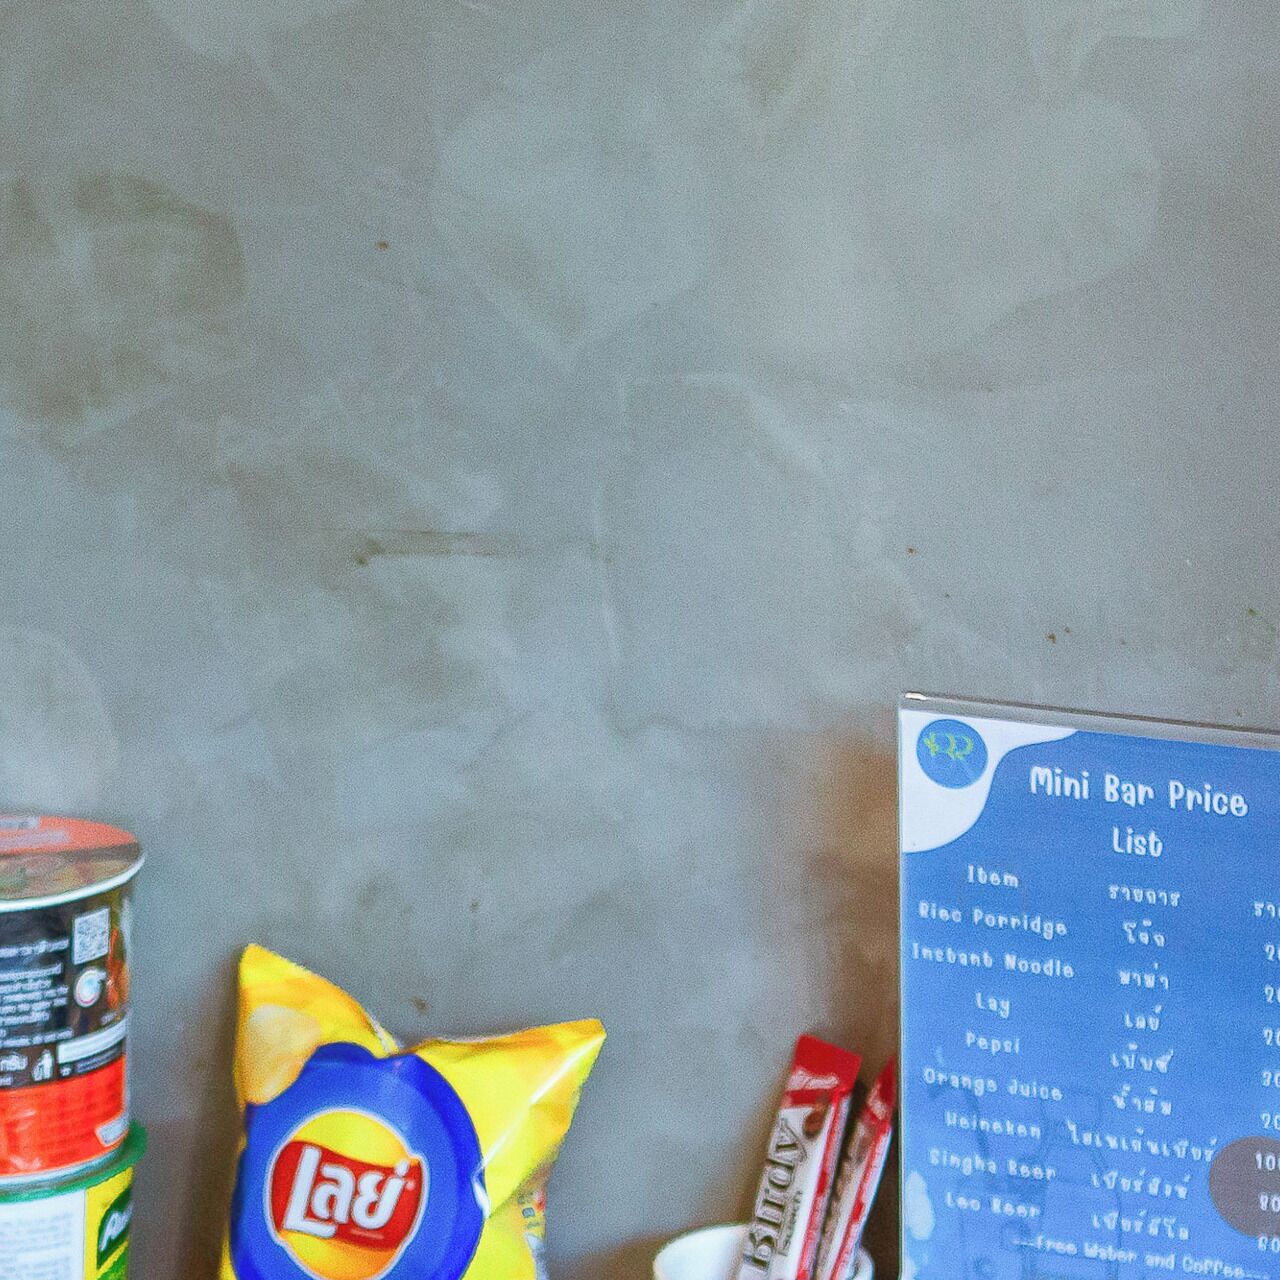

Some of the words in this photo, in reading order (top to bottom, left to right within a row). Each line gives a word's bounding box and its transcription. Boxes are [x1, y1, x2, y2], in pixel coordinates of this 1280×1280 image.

[1029, 765, 1090, 800] Mini
[1104, 770, 1154, 807] Bar
[1170, 779, 1249, 817] Price
[1113, 826, 1163, 857] List
[968, 865, 1019, 888] Item
[919, 901, 962, 923] Rice
[973, 907, 1068, 940] Porridge
[913, 942, 993, 968] Instant
[1004, 953, 1075, 978] Noodle
[976, 992, 1010, 1019] Lay
[966, 1031, 1020, 1056] Pepsi
[924, 1068, 998, 1096] Orange
[944, 1110, 1041, 1138] Heineken
[928, 1148, 997, 1176] Singha
[1007, 1159, 1057, 1180] Beer
[744, 1117, 807, 1271] Birdy
[946, 1191, 981, 1211] Leo
[990, 1196, 1040, 1218] Beer
[1083, 1242, 1138, 1262] Water
[1145, 1253, 1176, 1271] and
